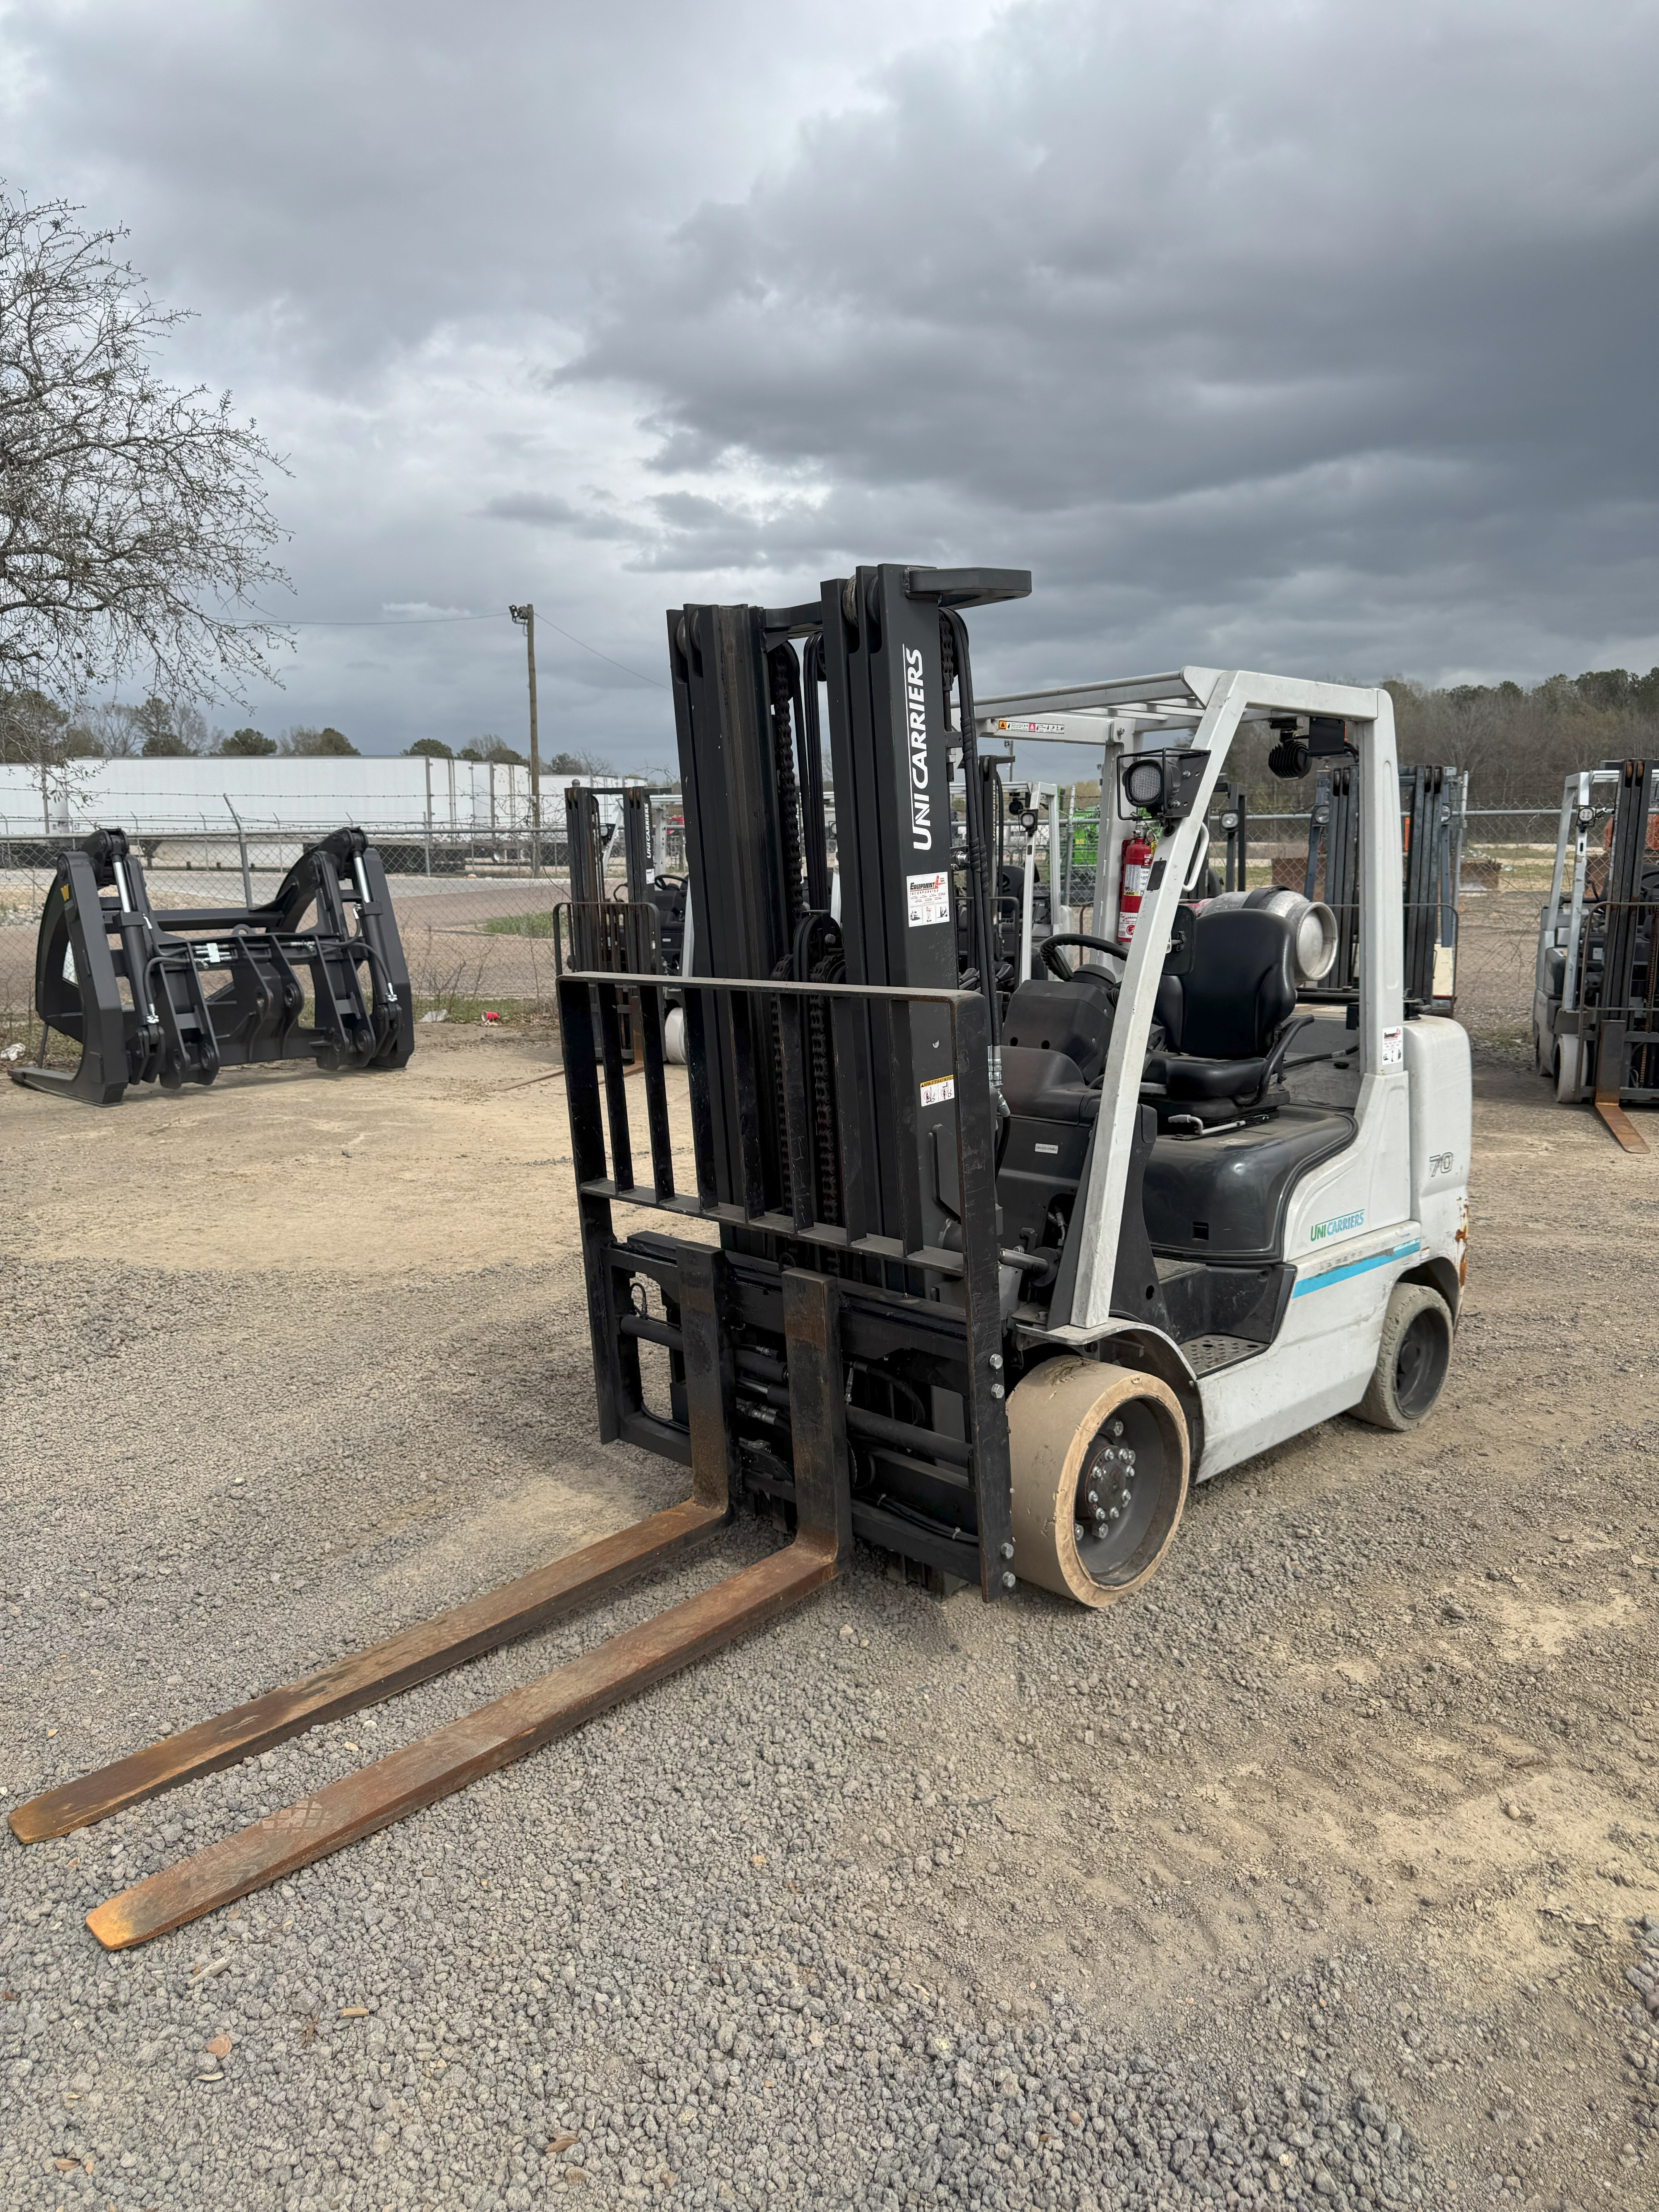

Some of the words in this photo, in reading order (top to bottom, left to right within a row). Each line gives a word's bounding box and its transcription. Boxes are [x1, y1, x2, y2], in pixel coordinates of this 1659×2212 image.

[903, 644, 932, 850] UNICARRIERS
[1429, 1152, 1453, 1177] 70
[1310, 1209, 1365, 1242] UNICARRIERS
